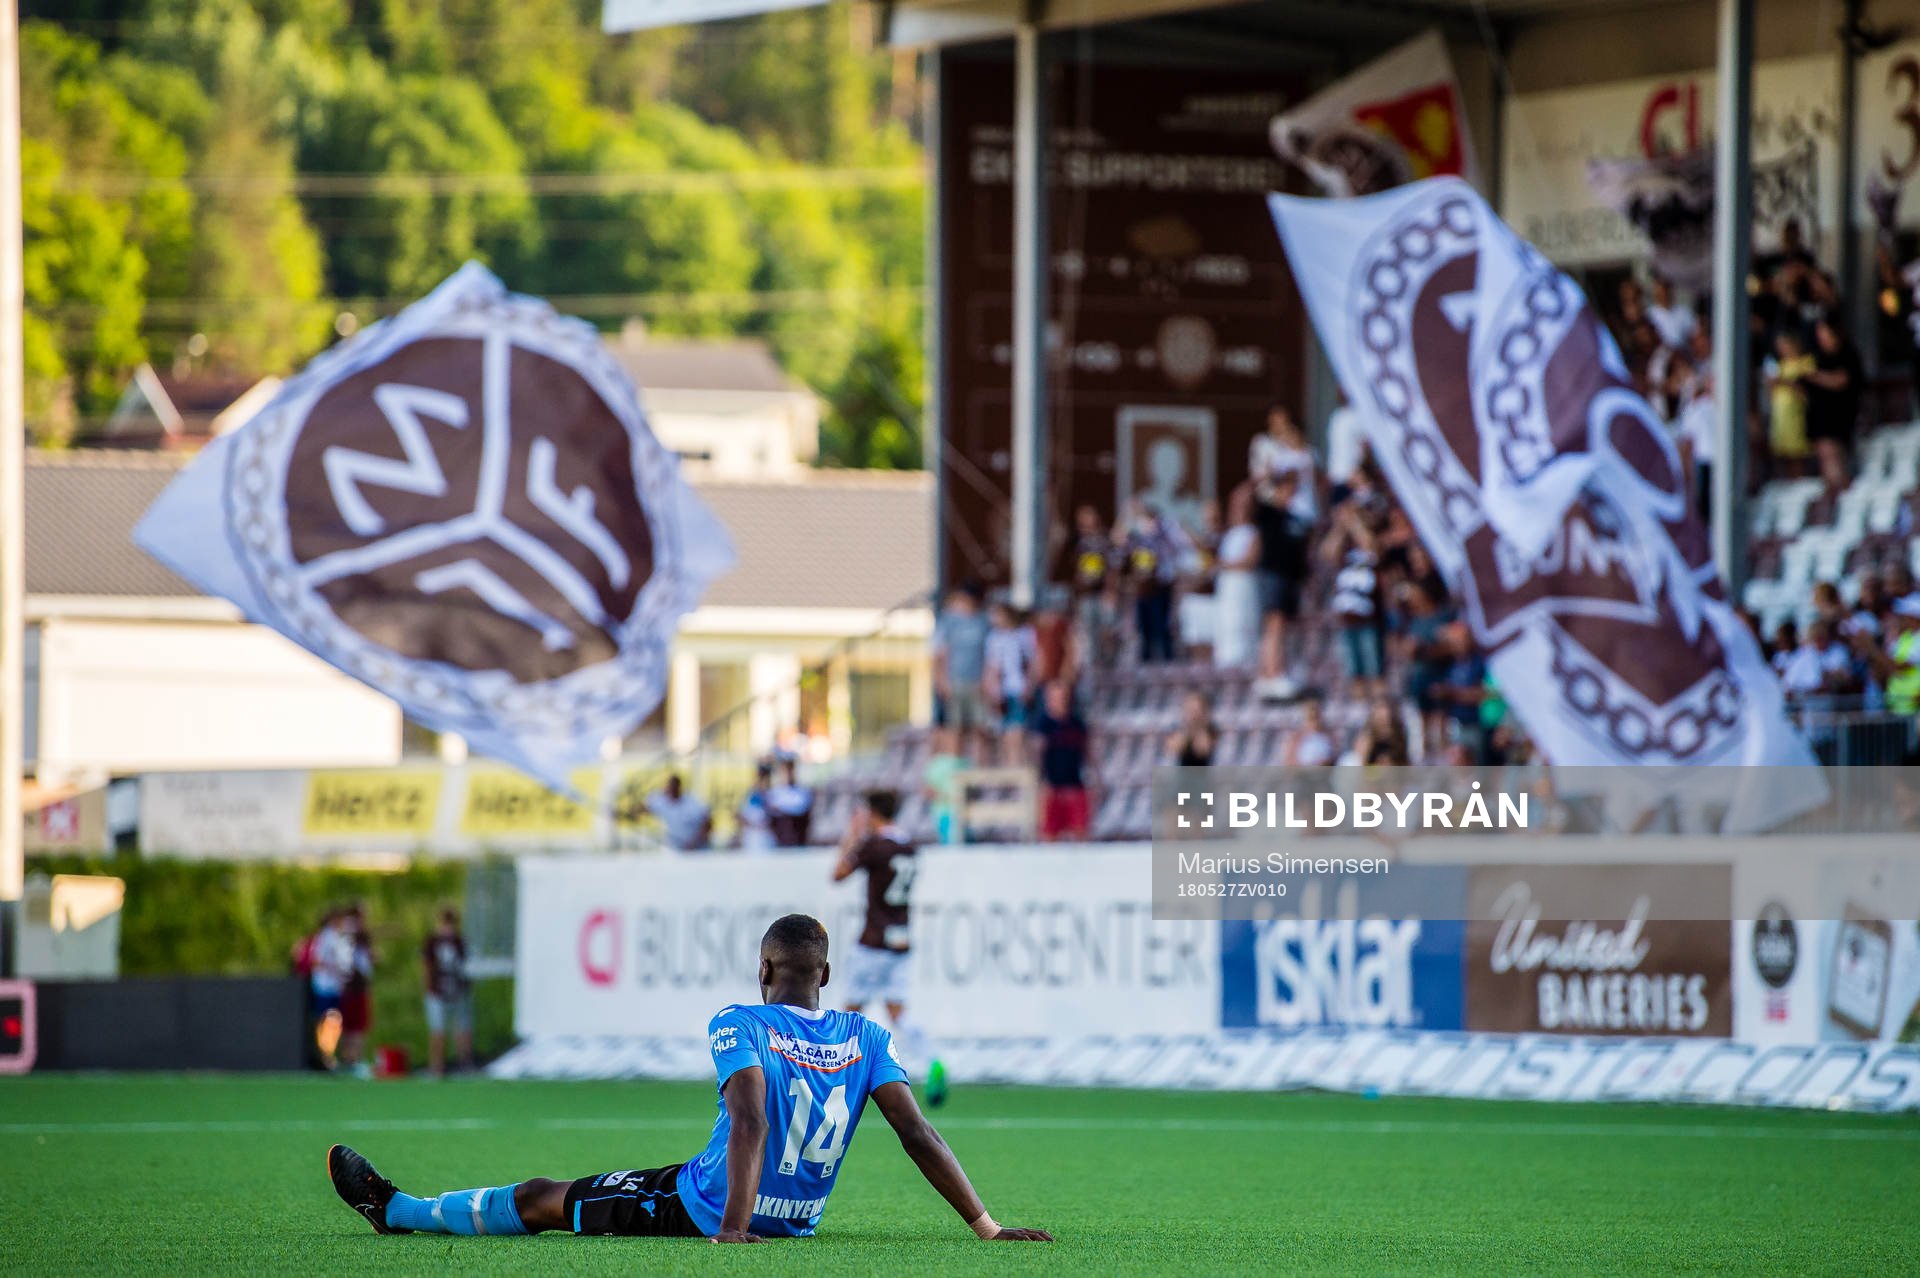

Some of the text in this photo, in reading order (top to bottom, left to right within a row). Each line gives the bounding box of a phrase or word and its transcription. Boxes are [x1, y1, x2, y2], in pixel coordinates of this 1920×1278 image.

[1490, 881, 1651, 974] United
[1537, 973, 1709, 1030] BAKERIES
[714, 1037, 738, 1056] Hus
[778, 1077, 849, 1178] 14
